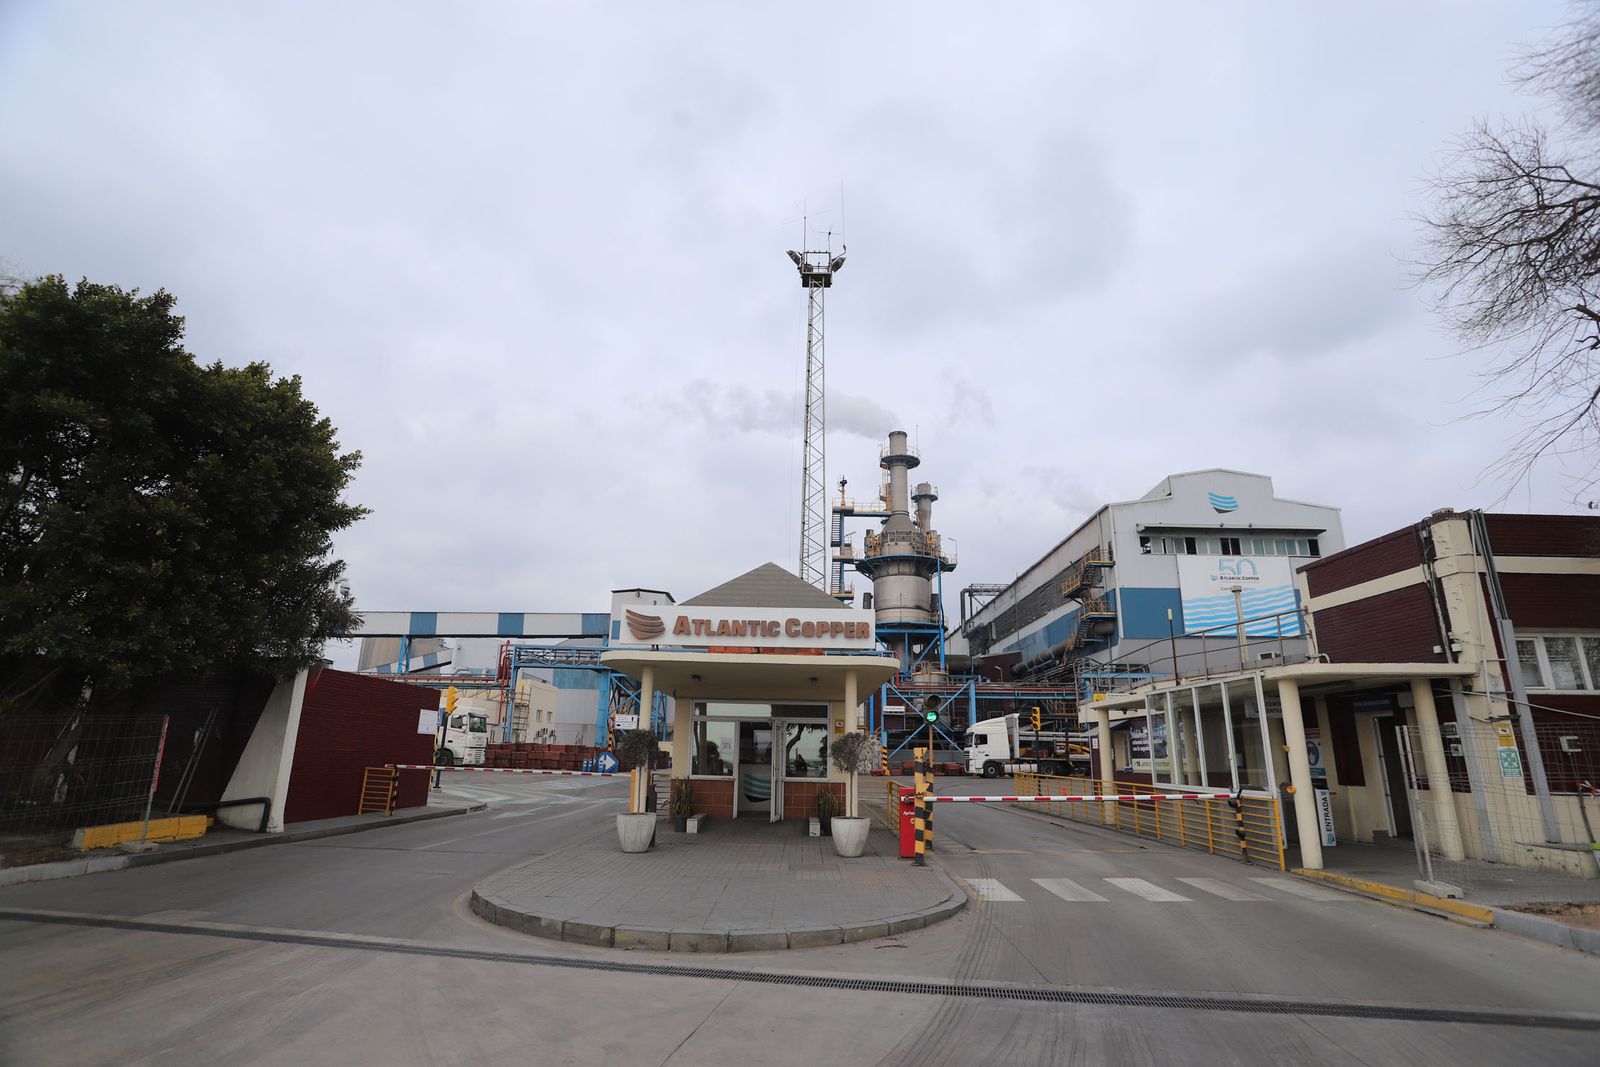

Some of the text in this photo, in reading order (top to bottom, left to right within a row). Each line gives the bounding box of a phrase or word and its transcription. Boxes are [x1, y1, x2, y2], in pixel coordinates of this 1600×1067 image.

[672, 615, 870, 639] ATLANTIC COPPER
[1322, 796, 1333, 832] ENTRADA
